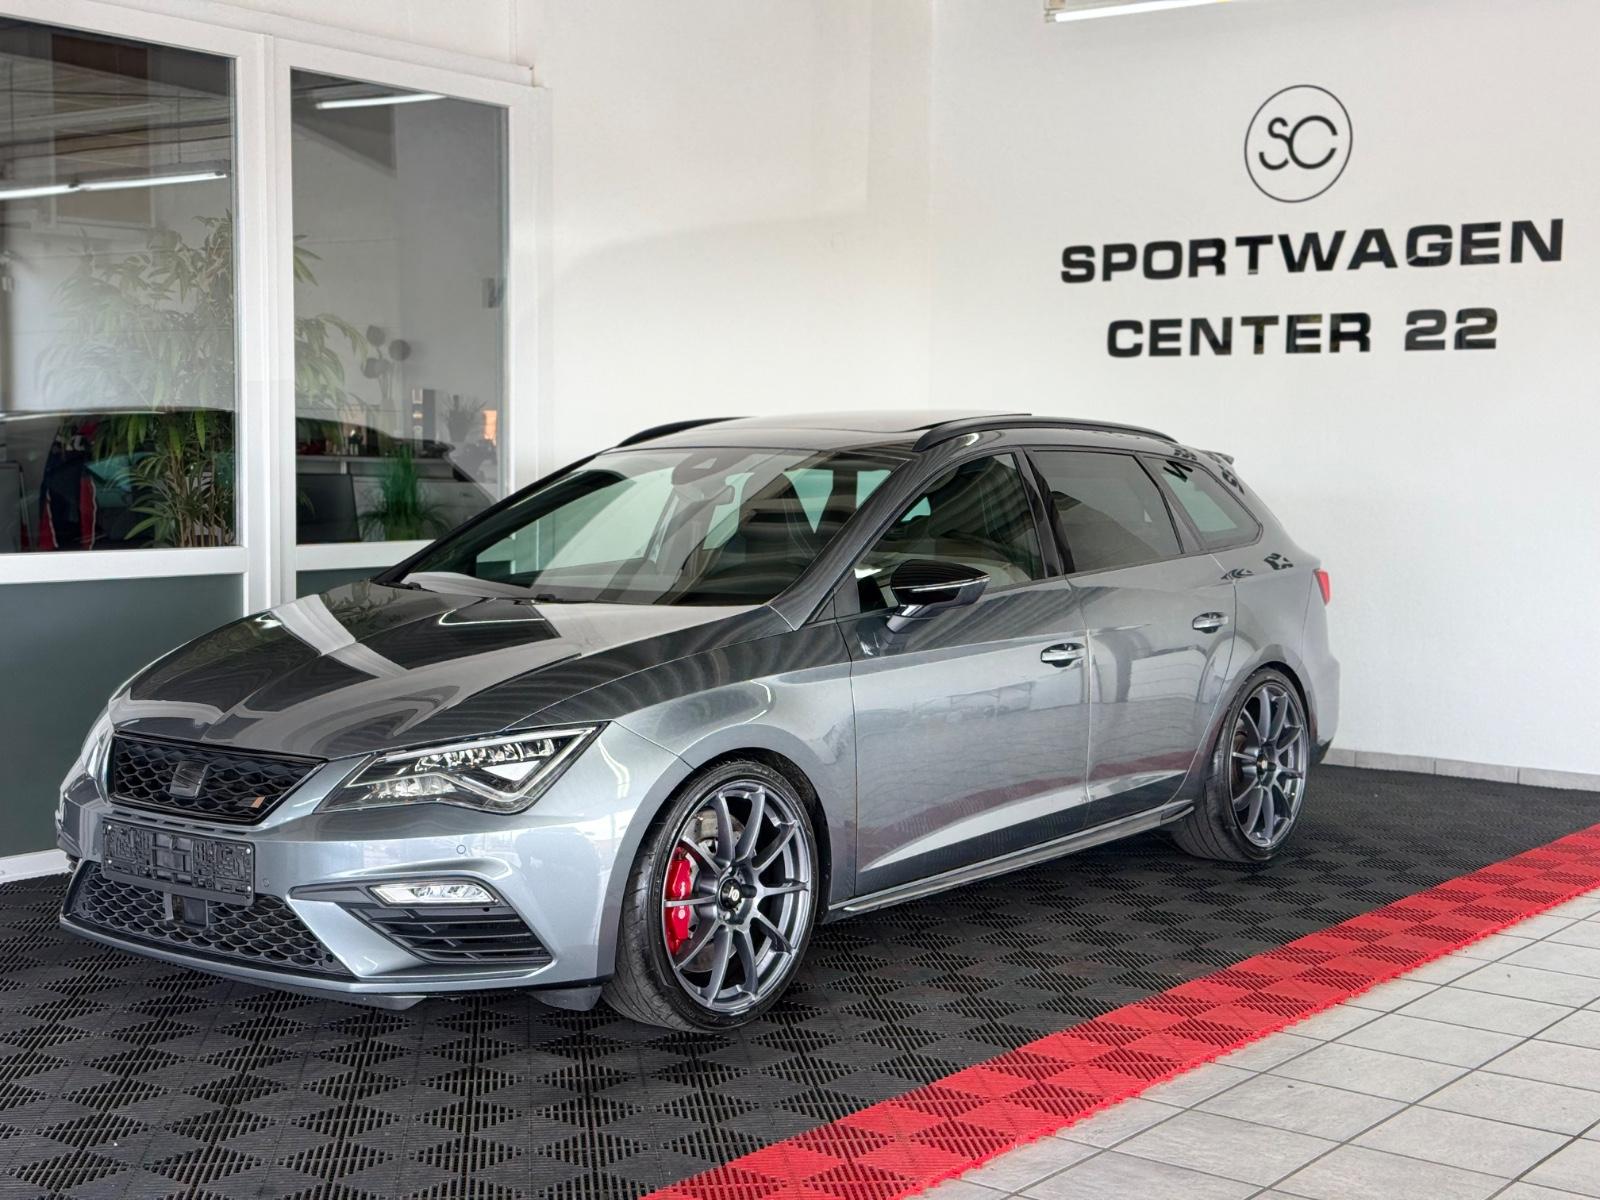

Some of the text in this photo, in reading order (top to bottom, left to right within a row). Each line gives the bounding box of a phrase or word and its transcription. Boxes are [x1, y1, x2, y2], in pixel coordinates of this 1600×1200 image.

[1258, 114, 1338, 171] SC
[1060, 218, 1564, 284] SPORTWAGEN
[1106, 307, 1498, 359] CENTER 22
